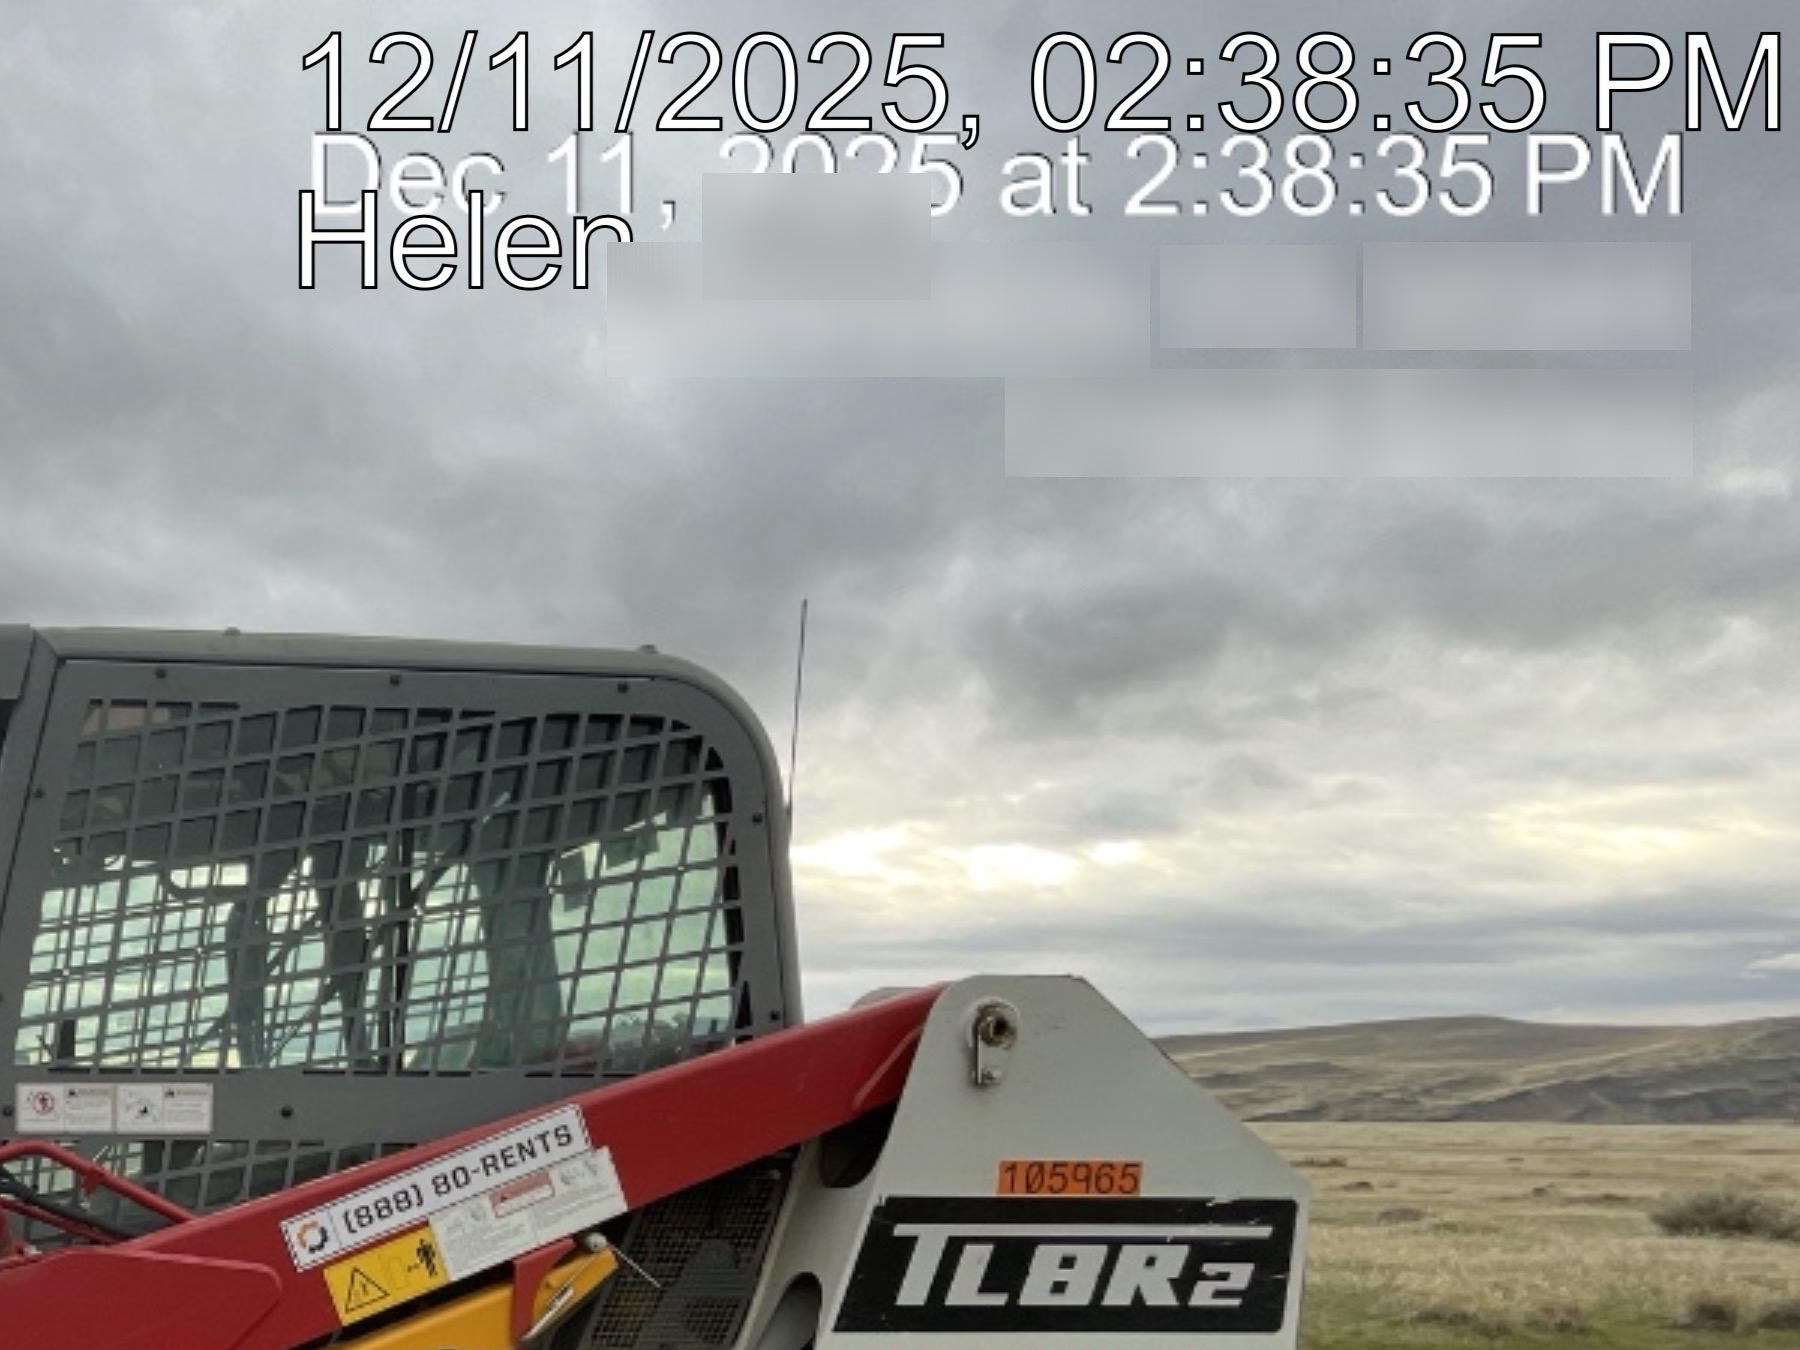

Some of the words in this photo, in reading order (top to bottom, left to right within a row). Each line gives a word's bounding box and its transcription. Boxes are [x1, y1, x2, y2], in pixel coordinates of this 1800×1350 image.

[344, 1183, 424, 1234] (888)
[431, 1123, 573, 1195] 80-RENTS
[1003, 1161, 1141, 1194] 105965
[893, 1224, 1273, 1307] TL8R2
